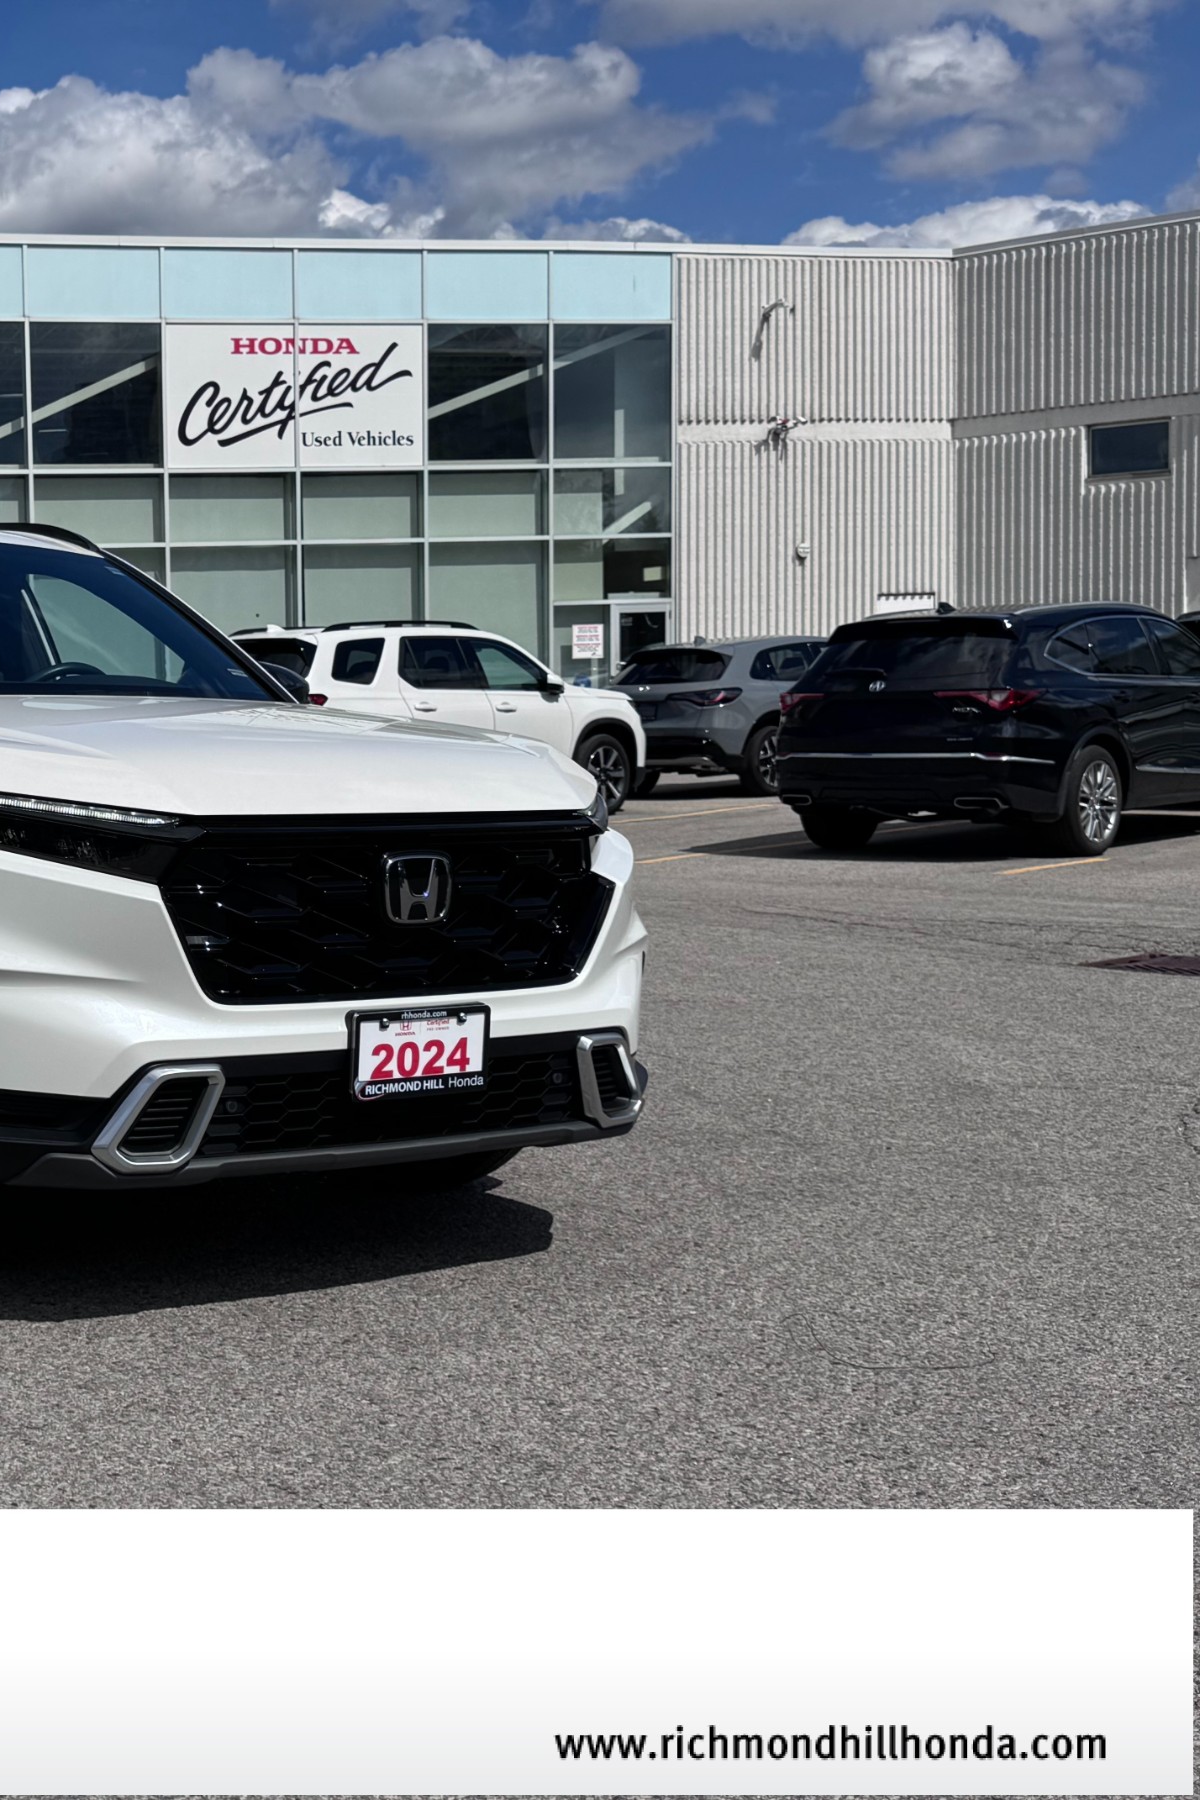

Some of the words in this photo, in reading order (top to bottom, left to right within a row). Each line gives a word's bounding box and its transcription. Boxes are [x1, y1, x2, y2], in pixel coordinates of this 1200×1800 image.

[230, 337, 360, 355] HONDA
[177, 341, 413, 448] Certified
[301, 430, 342, 447] Used
[347, 430, 414, 447] Vehicles
[401, 1010, 448, 1020] rhhonda.com
[370, 1037, 470, 1080] 2024
[365, 1080, 422, 1095] RICHMOND
[423, 1078, 444, 1090] HILL
[448, 1074, 484, 1088] Honda
